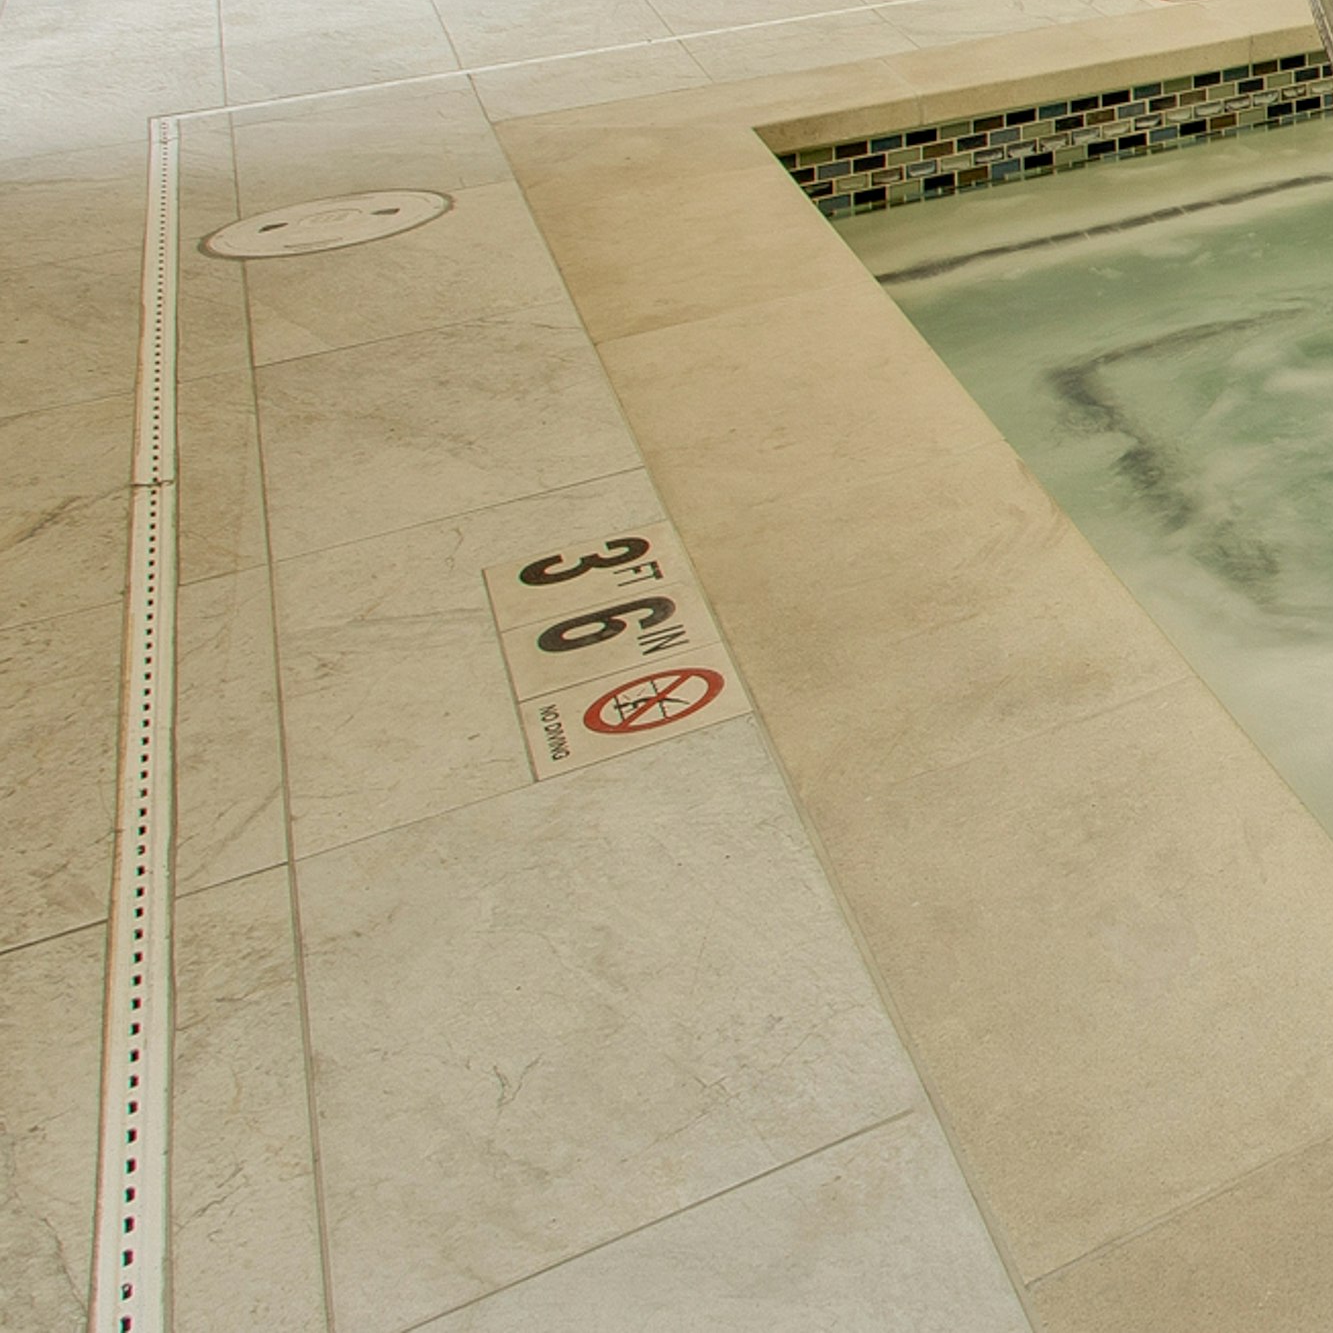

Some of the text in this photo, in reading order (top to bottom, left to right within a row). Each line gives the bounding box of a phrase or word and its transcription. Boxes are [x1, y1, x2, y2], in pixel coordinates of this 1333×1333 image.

[518, 537, 664, 587] 3 FT
[537, 596, 690, 656] 6 IN
[540, 704, 571, 761] NO DIVING
